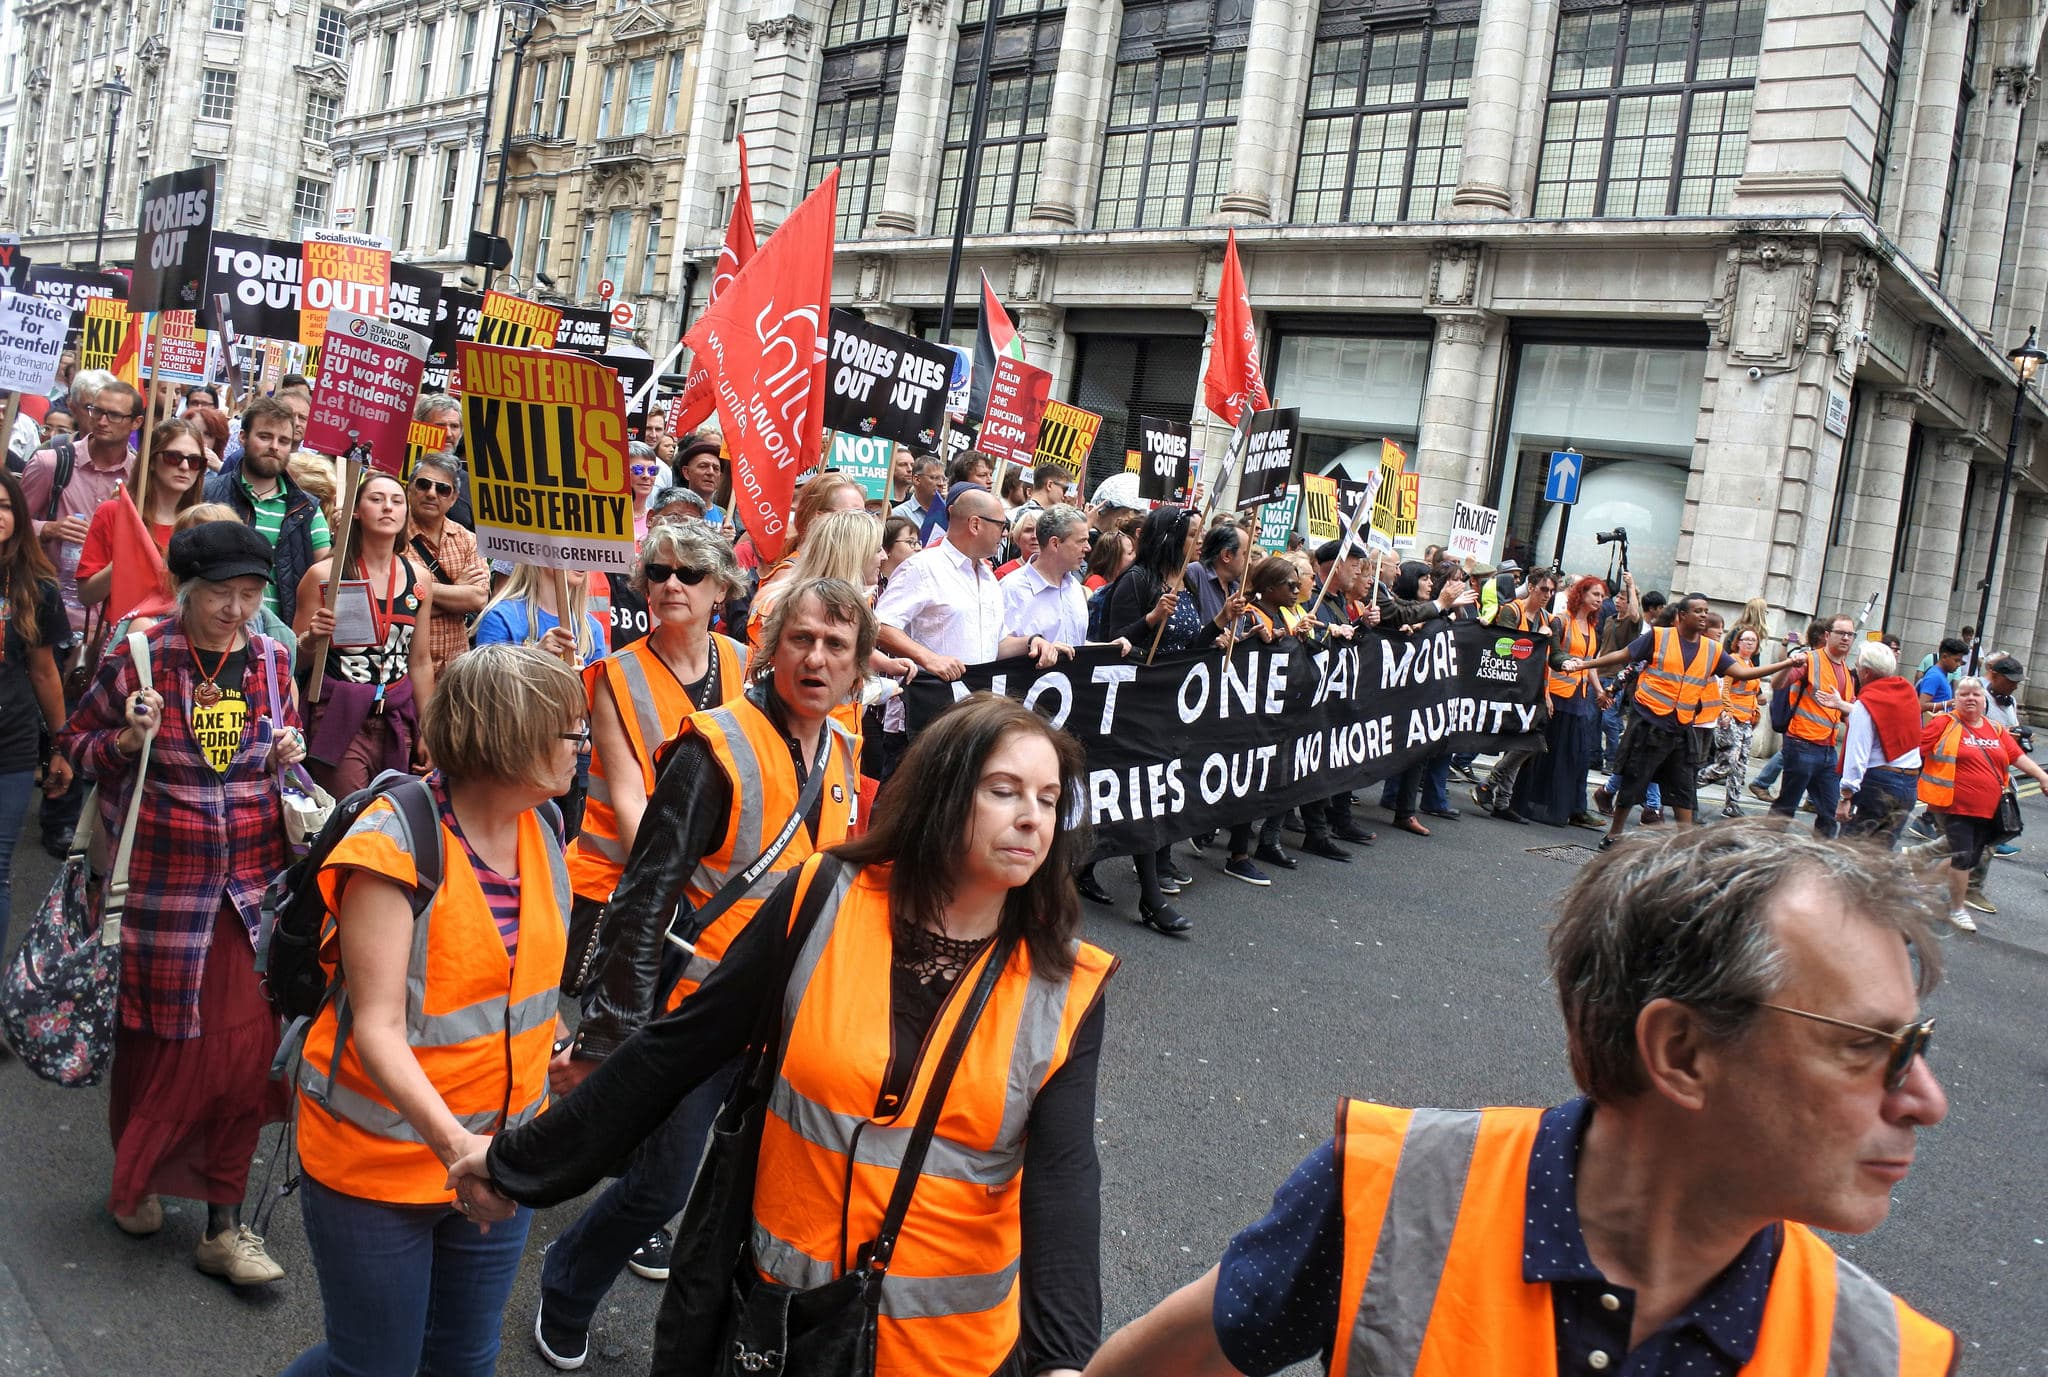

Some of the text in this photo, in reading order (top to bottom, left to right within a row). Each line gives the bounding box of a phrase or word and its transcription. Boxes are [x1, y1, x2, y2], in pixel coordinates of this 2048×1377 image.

[144, 189, 208, 234] TORIES
[151, 230, 189, 270] OUT
[315, 232, 382, 248] Socialist Worker
[214, 246, 303, 285] TORI
[309, 243, 385, 267] KICK THE
[308, 259, 385, 286] TORIES
[35, 280, 114, 300] NOT ONE
[307, 277, 385, 315] OUT!
[390, 281, 421, 305] NE
[602, 283, 611, 295] P
[8, 296, 62, 322] Justice
[390, 301, 431, 327] ORE
[484, 293, 561, 332] AUSTERITY
[20, 315, 45, 335] for
[163, 322, 194, 339] OUT!
[370, 324, 409, 341] STAND UP
[575, 321, 601, 334] ONE
[369, 333, 411, 352] TO RACISM
[570, 333, 606, 347] MORE
[13, 353, 55, 373] demand
[177, 347, 205, 358] RESIST
[327, 336, 381, 366] Hands
[384, 355, 409, 374] off
[831, 329, 898, 378] TORIES
[18, 368, 43, 385] truth
[323, 354, 349, 374] EU
[352, 365, 416, 397] workers
[898, 352, 946, 391] RIES
[999, 370, 1021, 385] HEALTH
[1001, 361, 1014, 370] FOR
[465, 348, 617, 409] AUSTERITY
[834, 366, 876, 402] OUT
[996, 382, 1018, 397] HOMES
[320, 371, 408, 413] & students
[890, 382, 929, 414] UT
[992, 395, 1009, 407] JOBS
[316, 389, 391, 424] Let them
[989, 407, 1024, 425] EDUCATION
[1043, 401, 1100, 433] AUSTERITY
[313, 409, 350, 432] stay
[750, 392, 795, 470] UNION
[985, 420, 1026, 444] JC4PM
[467, 395, 625, 493] KILLS
[835, 436, 889, 465] NOT
[1036, 418, 1093, 462] KILLS
[1145, 430, 1187, 459] TORIES
[1249, 429, 1290, 452] NOT ONE
[1154, 454, 1178, 478] OUT
[1245, 454, 1264, 475] DAY
[1262, 448, 1292, 471] MORE
[478, 482, 626, 536] AUSTERITY
[1265, 510, 1291, 524] WAR
[1307, 491, 1338, 525] KILLS
[1262, 524, 1289, 538] NOT
[1310, 521, 1339, 539] AUSTERITY
[1482, 649, 1492, 657] THE
[1177, 651, 1290, 724] ONE
[1311, 645, 1360, 708] DAY
[1380, 630, 1458, 689] MORE
[1476, 667, 1518, 682] ASSEMBLY
[226, 688, 241, 699] the
[194, 712, 246, 729] AXE TH
[1064, 758, 1186, 831] RIES
[1200, 744, 1277, 805] OUT
[1294, 731, 1323, 782] NO
[1329, 715, 1393, 769] MORE
